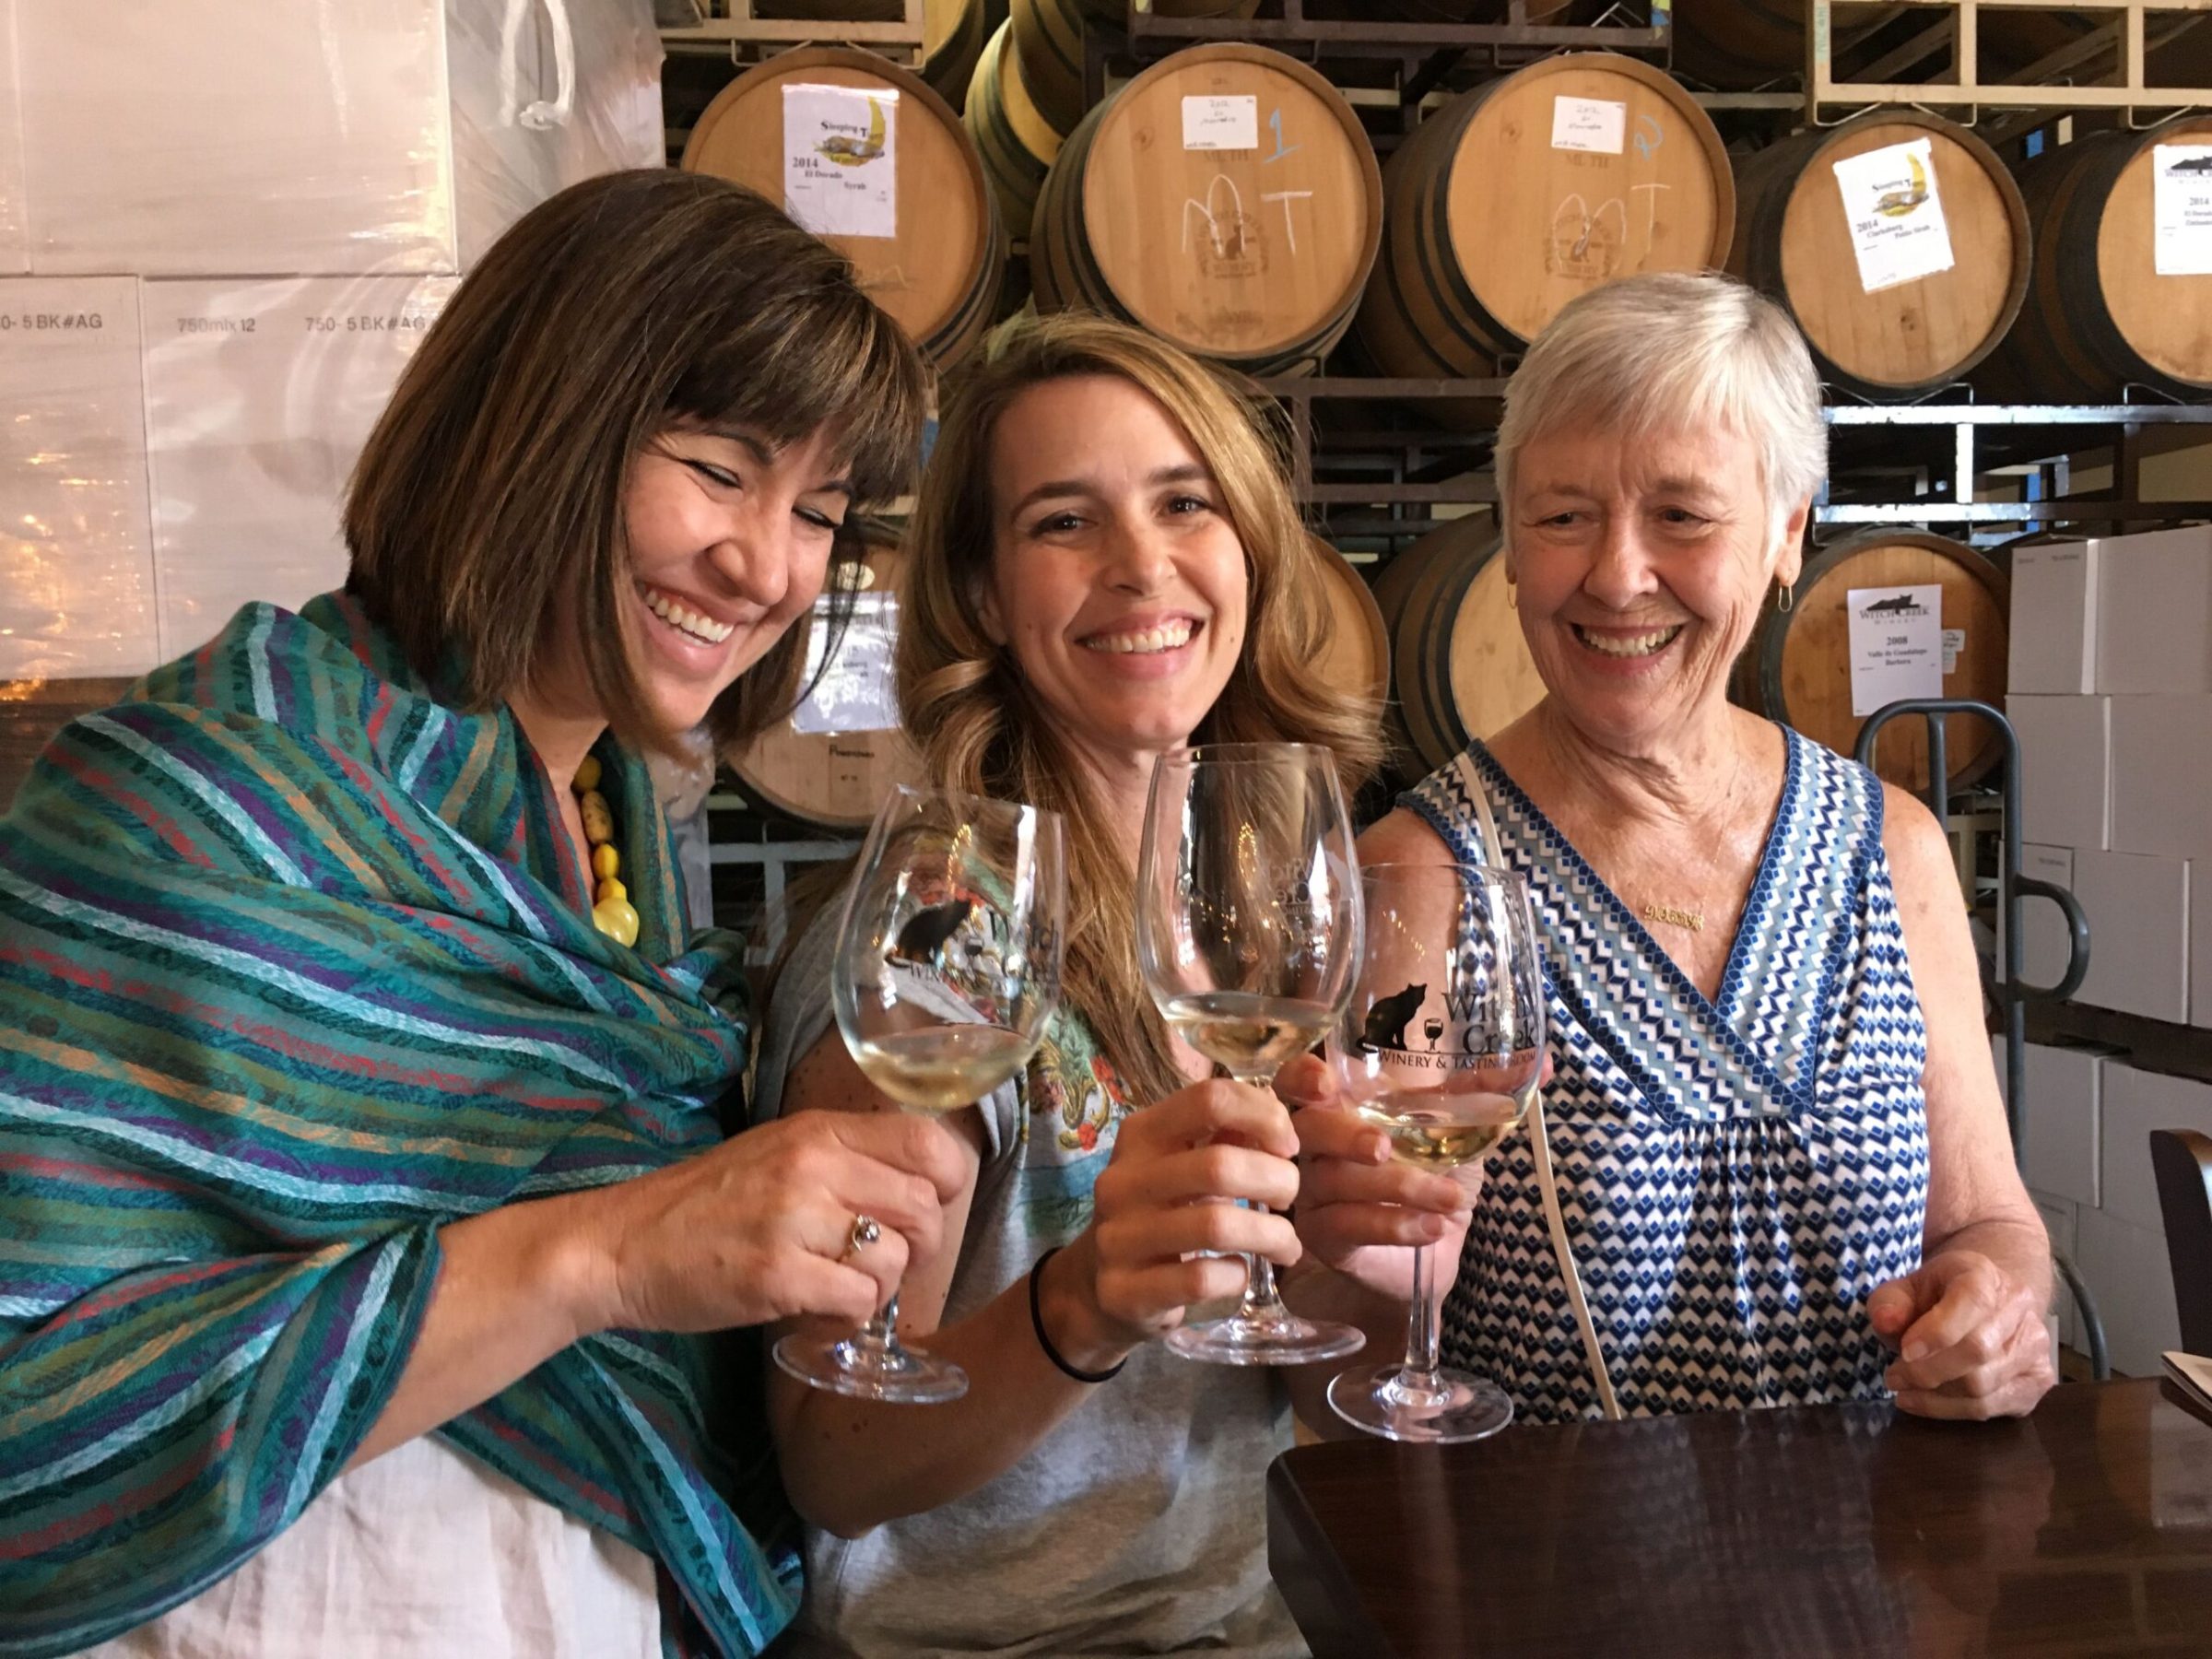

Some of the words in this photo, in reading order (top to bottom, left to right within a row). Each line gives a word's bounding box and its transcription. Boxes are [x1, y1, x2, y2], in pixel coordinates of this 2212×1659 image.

[793, 157, 818, 169] 2014
[2189, 196, 2209, 206] 2014
[1856, 219, 1878, 232] 2014
[1887, 635, 1908, 646] 2008
[1379, 1052, 1432, 1068] WINERY
[1436, 1055, 1447, 1069] &
